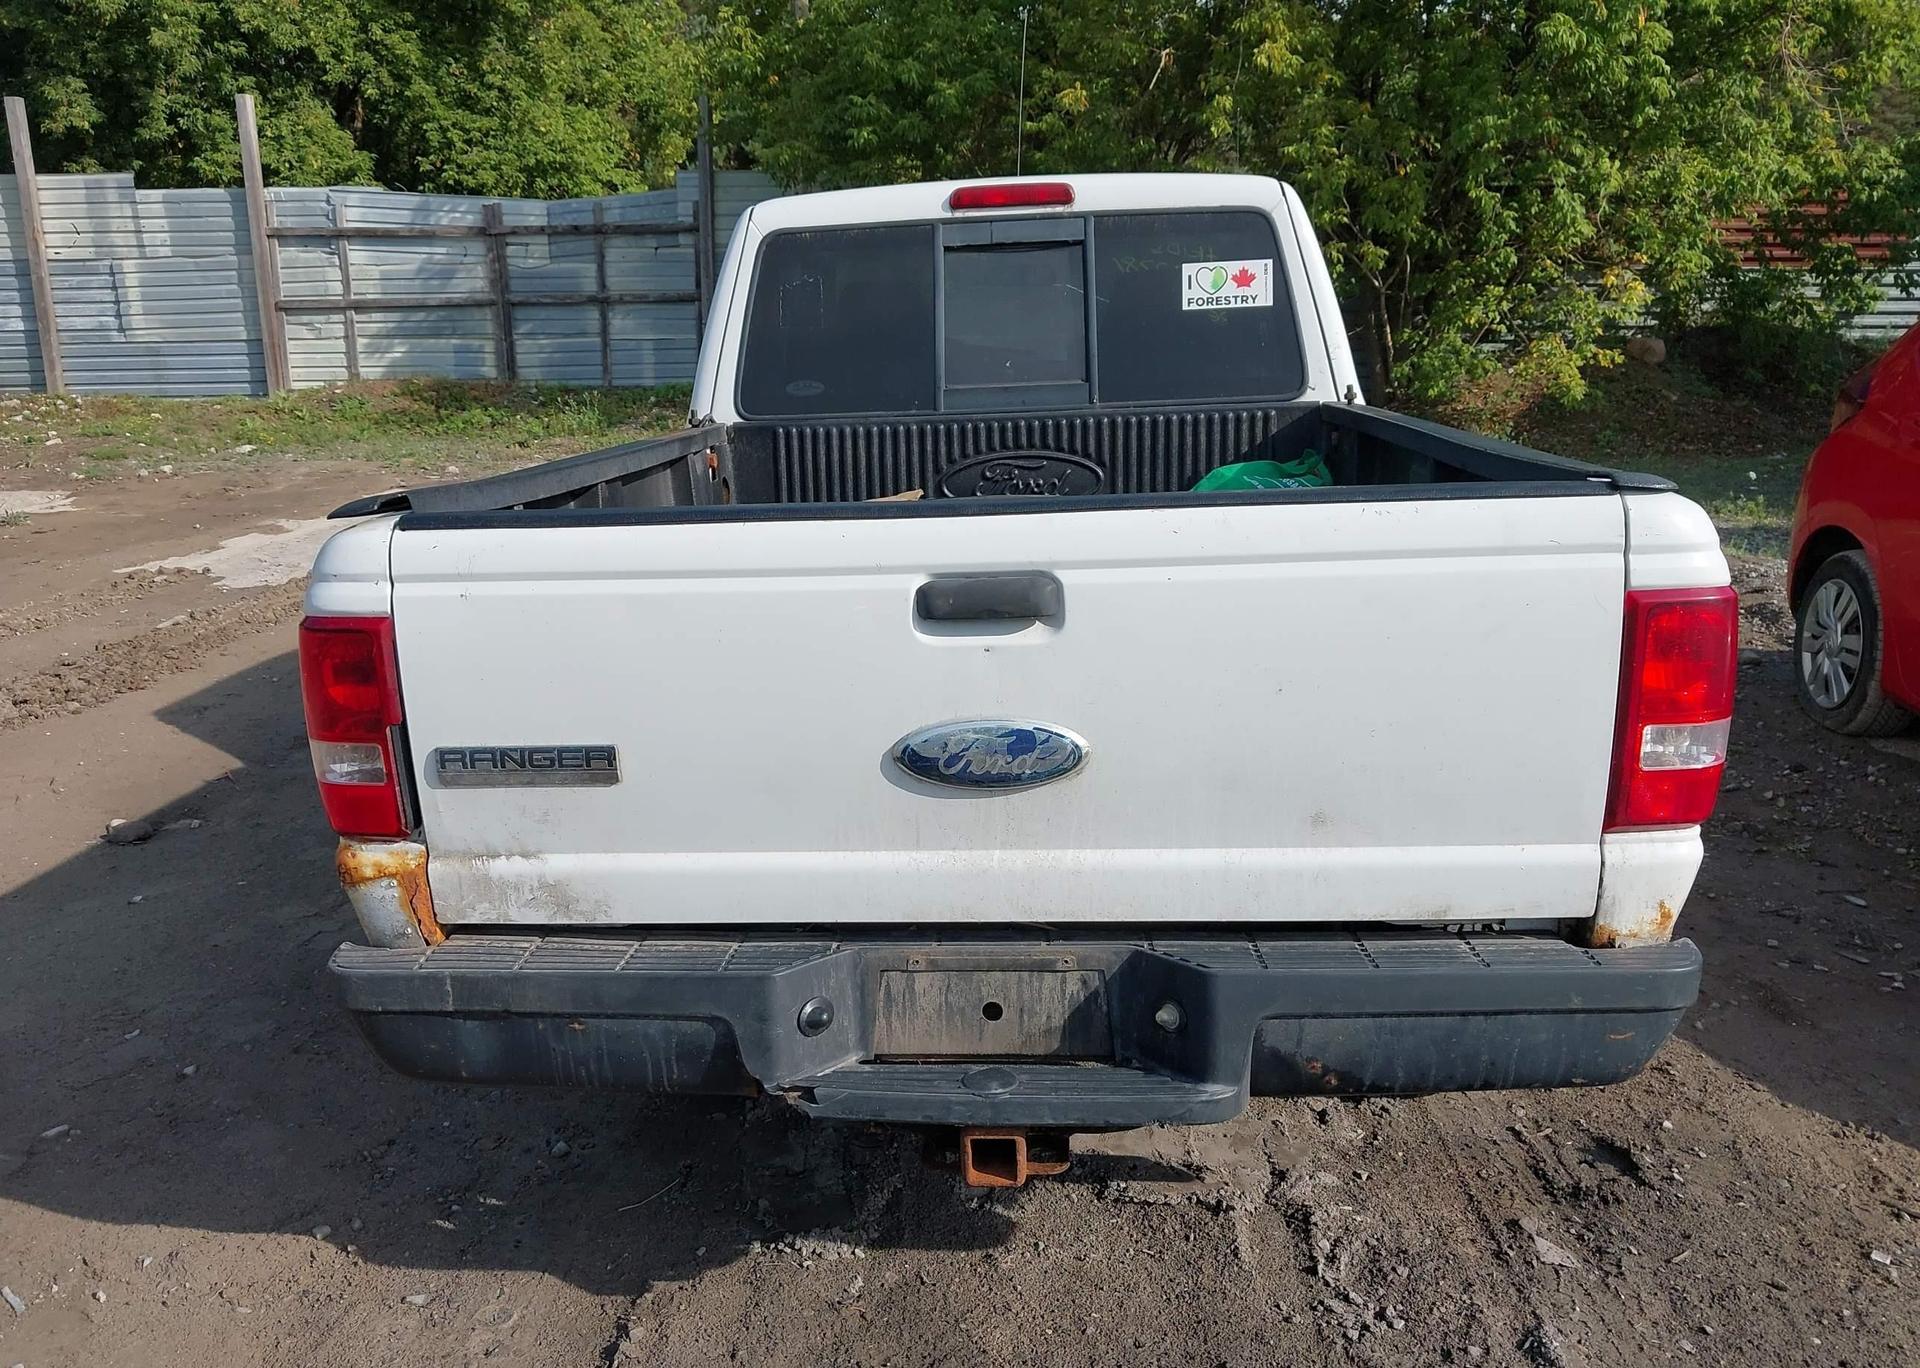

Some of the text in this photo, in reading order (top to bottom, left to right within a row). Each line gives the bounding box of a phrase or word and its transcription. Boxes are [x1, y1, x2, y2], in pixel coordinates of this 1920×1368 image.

[1187, 274, 1192, 290] I
[1187, 294, 1258, 307] FORESTRY
[974, 459, 1072, 496] Ford
[439, 749, 615, 769] RANGER
[937, 734, 1059, 775] Ford
